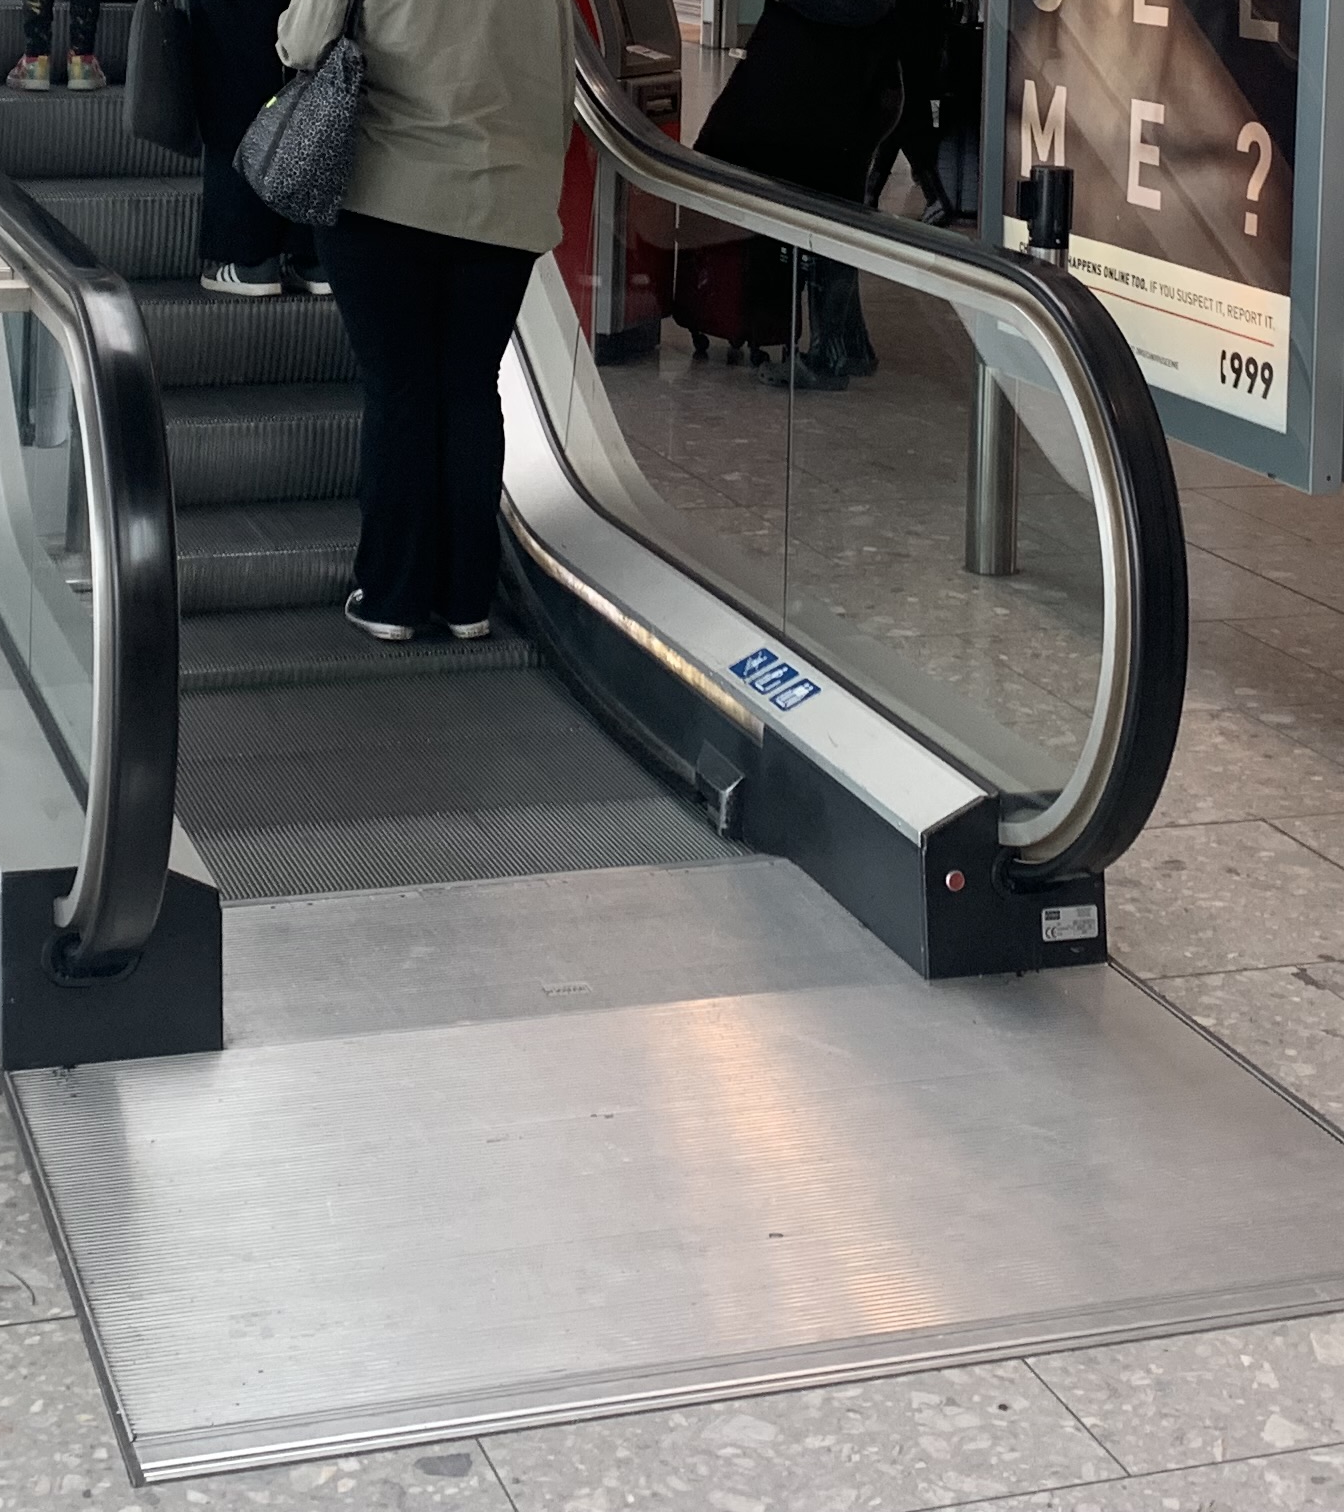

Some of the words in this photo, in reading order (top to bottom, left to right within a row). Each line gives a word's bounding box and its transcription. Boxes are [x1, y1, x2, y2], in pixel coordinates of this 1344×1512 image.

[1103, 265, 1130, 286] ONLINE
[1149, 280, 1158, 294] IF
[1159, 283, 1175, 300] YOU
[1176, 287, 1214, 312] SUSPECT
[1227, 304, 1263, 326] REPORT
[1230, 351, 1274, 400] 999
